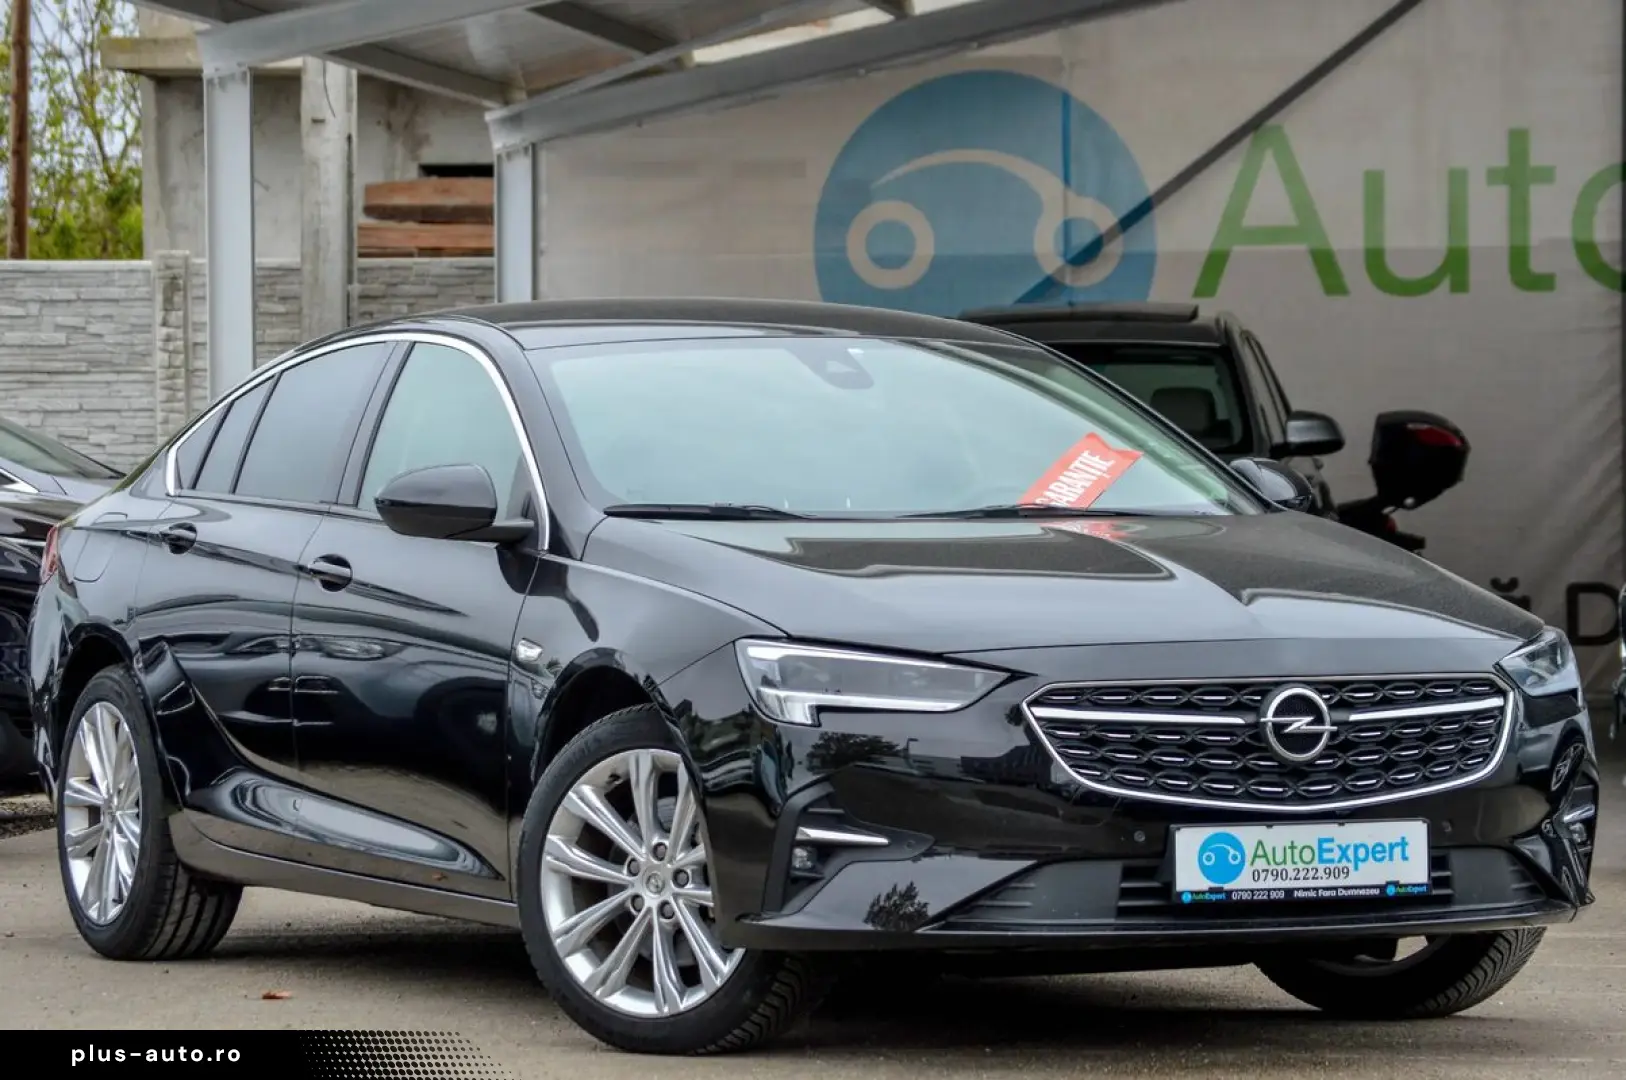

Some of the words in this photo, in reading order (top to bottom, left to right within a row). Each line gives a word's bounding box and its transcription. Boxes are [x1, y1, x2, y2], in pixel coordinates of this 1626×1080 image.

[1250, 837, 1409, 871] AutoExpert
[1252, 866, 1350, 882] 0790.222.909
[1232, 891, 1252, 900] 0790
[1253, 891, 1268, 900] 222
[1270, 890, 1285, 899] 909
[1294, 889, 1316, 898] Nimic
[1318, 888, 1336, 897] Fara
[1337, 887, 1380, 896] Dumnezeu
